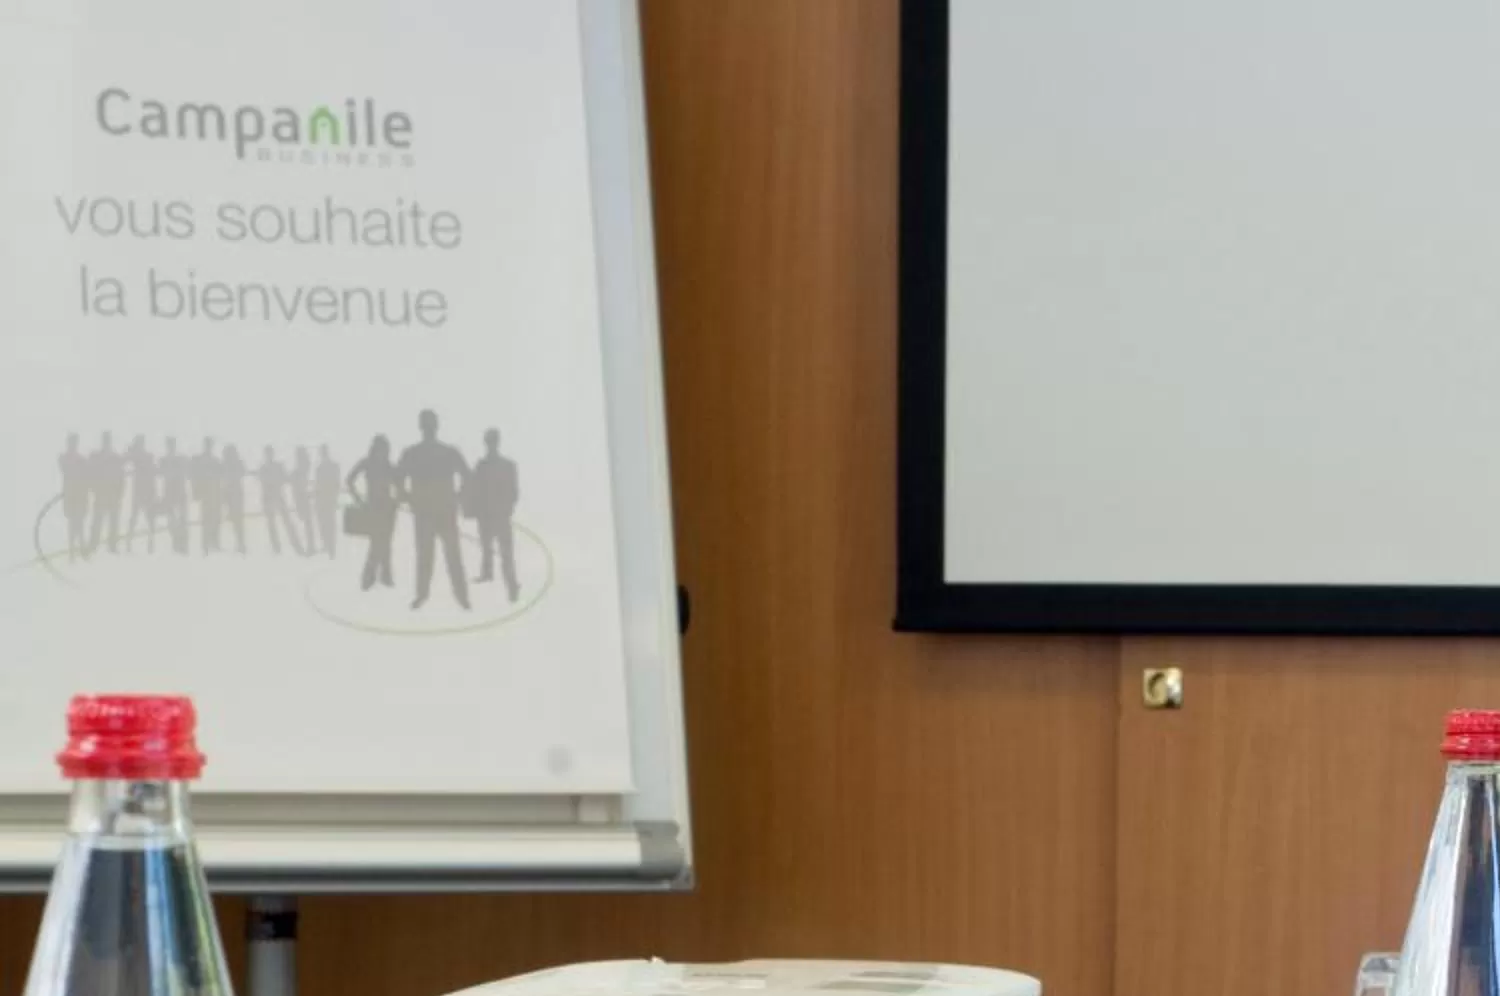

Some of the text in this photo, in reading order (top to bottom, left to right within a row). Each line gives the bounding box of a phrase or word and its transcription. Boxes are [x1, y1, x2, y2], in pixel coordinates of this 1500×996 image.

[95, 87, 414, 160] Campanile
[55, 195, 463, 250] vous souhaite
[79, 264, 450, 329] la bienvenue
